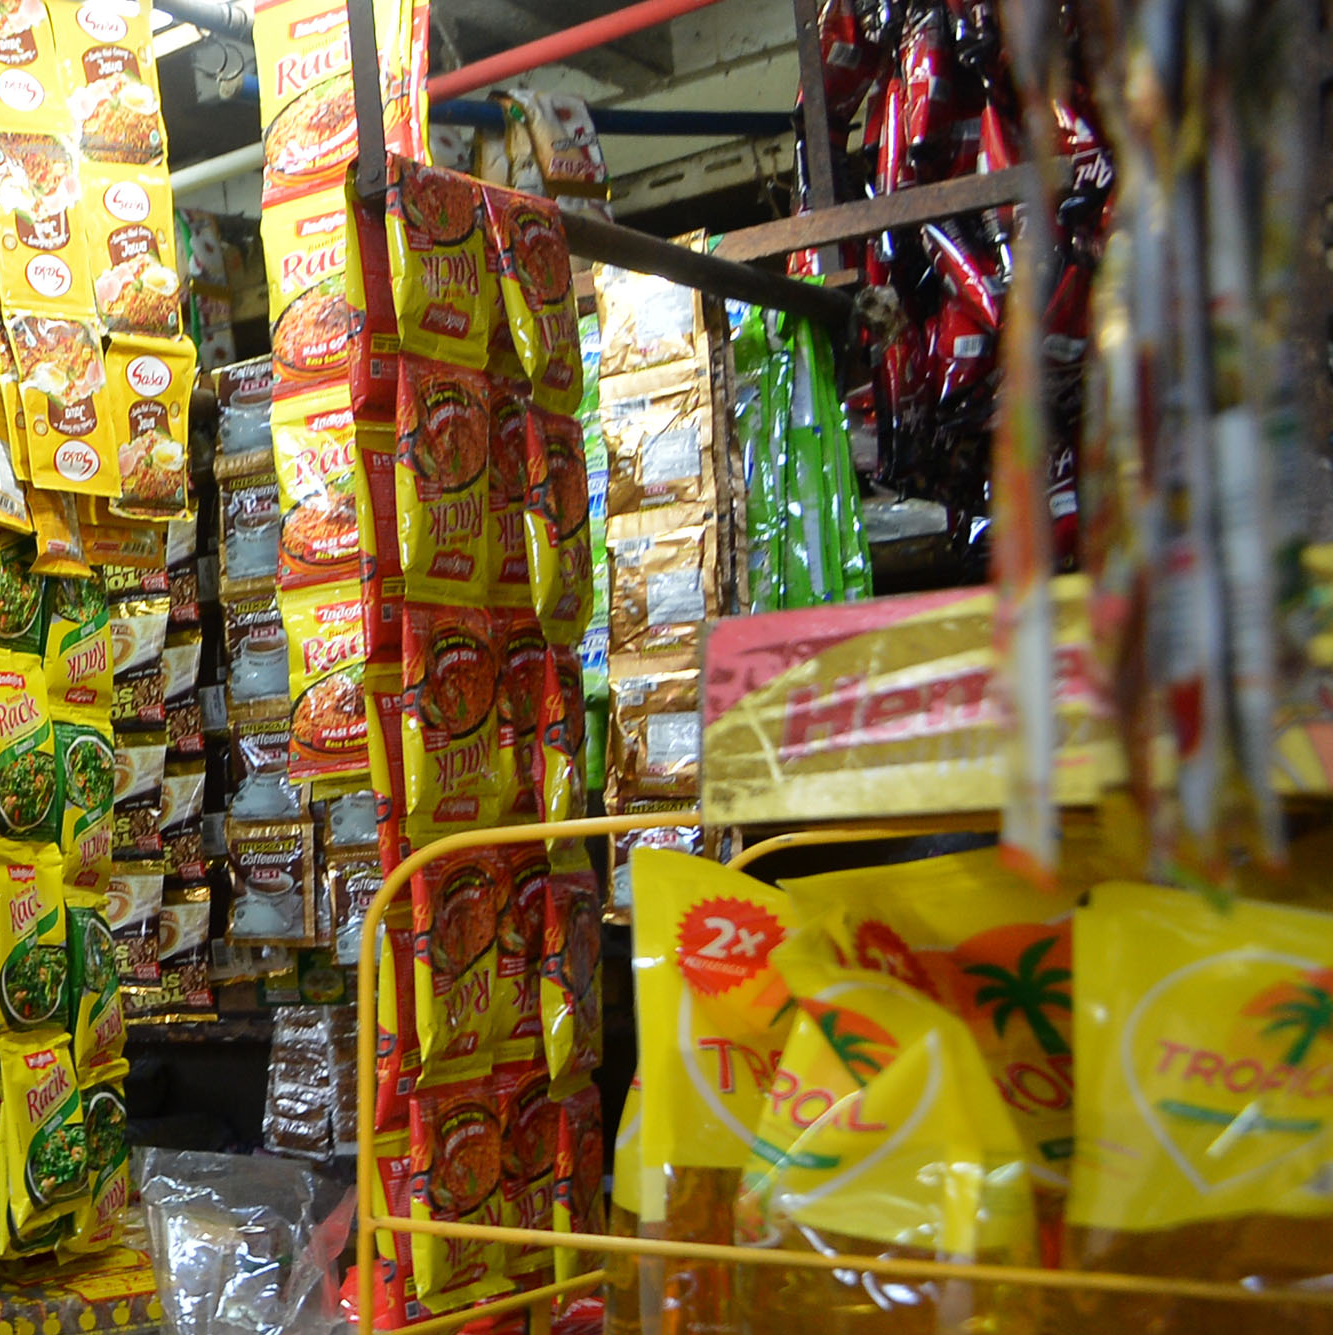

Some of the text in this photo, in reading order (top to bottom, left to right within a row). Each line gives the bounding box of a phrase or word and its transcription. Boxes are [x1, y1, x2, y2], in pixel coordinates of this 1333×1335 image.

[277, 30, 349, 96] Raci
[301, 212, 346, 236] Indofo
[120, 239, 148, 258] Jawa
[283, 241, 346, 294] Rac
[420, 250, 479, 300] Racik
[131, 361, 163, 386] Sasa
[228, 362, 273, 381] Coffeem
[312, 412, 354, 430] Indofo
[60, 449, 94, 476] Sasa
[295, 440, 356, 486] Rac
[233, 484, 279, 500] Coffeem
[429, 492, 484, 546] Racik
[496, 511, 524, 553] cik
[312, 536, 337, 549] NASI
[237, 610, 282, 625] Coffeem
[320, 605, 362, 622] Indofo
[67, 640, 106, 683] Racik
[302, 633, 365, 676] Rac
[322, 727, 347, 739] NASI
[346, 873, 384, 892] Coffee
[698, 916, 767, 959] 2x
[26, 1065, 69, 1123] Racik
